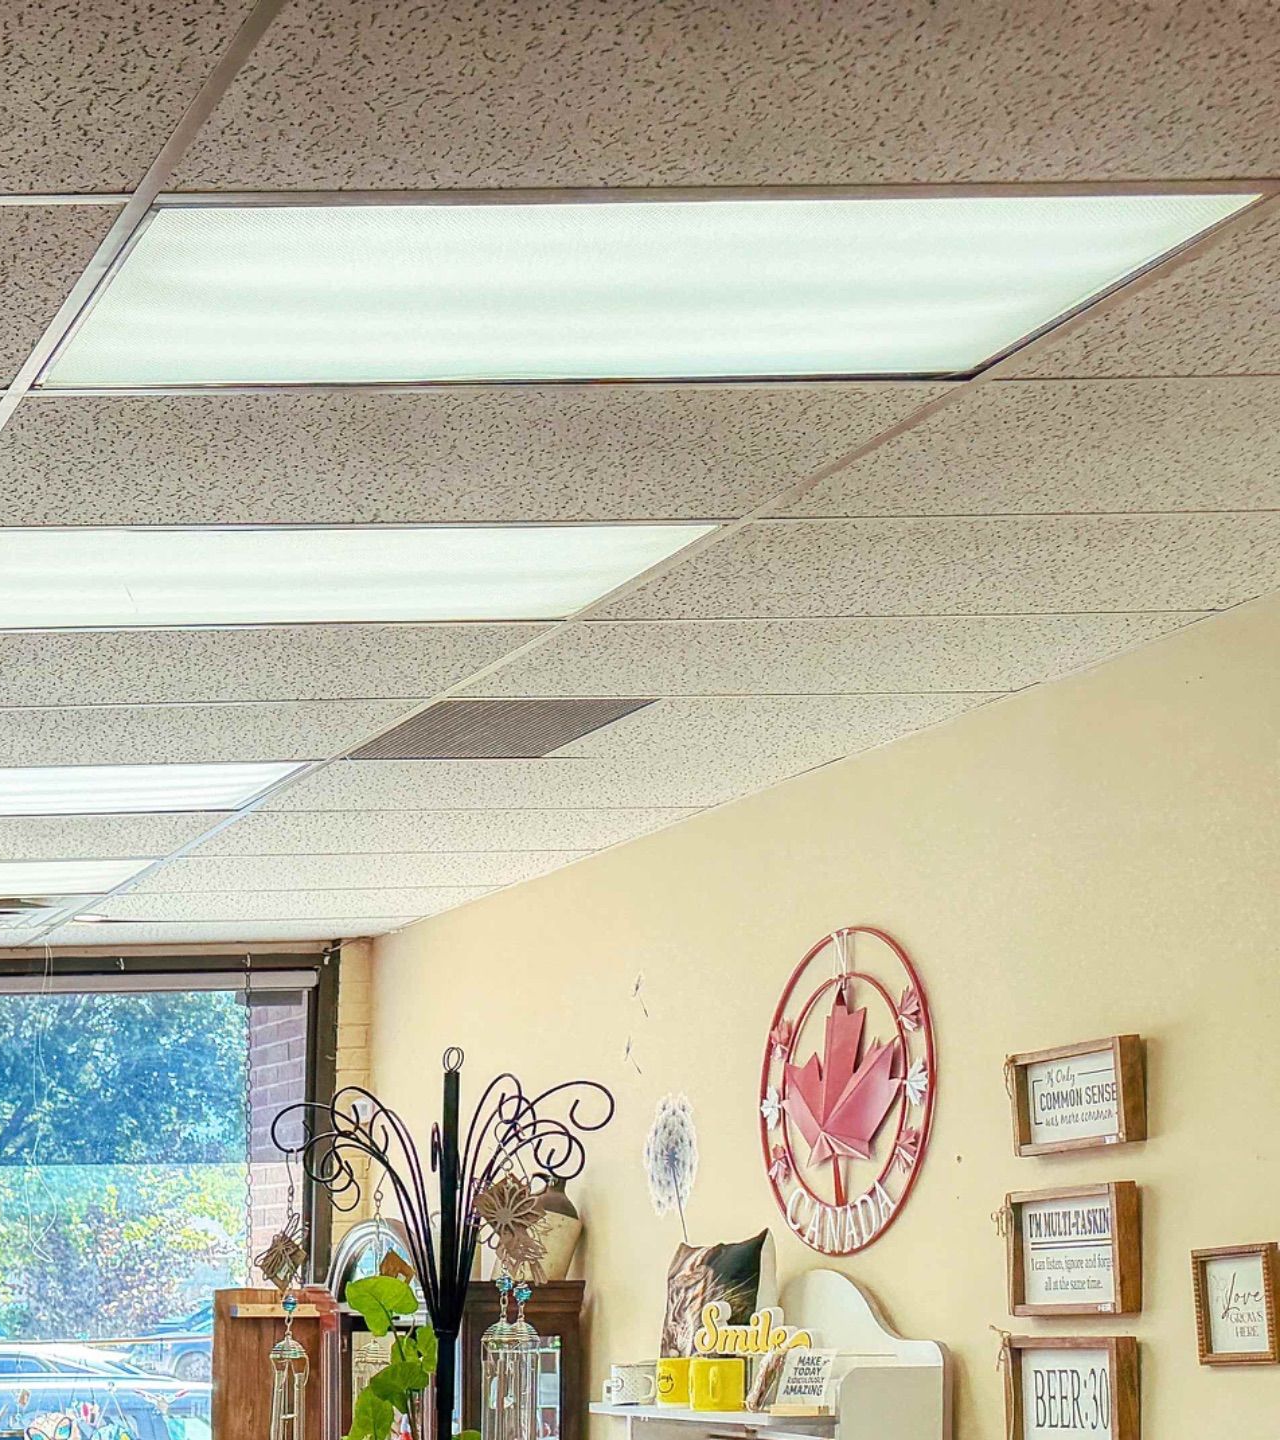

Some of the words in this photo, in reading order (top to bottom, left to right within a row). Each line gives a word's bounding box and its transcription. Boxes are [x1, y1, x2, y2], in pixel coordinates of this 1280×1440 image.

[1056, 1066, 1075, 1086] Only
[1040, 1088, 1082, 1111] COMMON
[1085, 1082, 1117, 1104] SENSE
[1045, 1115, 1058, 1126] was
[1061, 1113, 1079, 1124] more
[1081, 1109, 1113, 1122] common
[787, 1182, 896, 1254] CANADA
[1029, 1213, 1042, 1238] I'M
[1044, 1207, 1110, 1237] MULTI-TASKIN
[1035, 1261, 1045, 1270] can
[1065, 1256, 1084, 1272] ignore
[1085, 1254, 1096, 1268] and
[1097, 1253, 1112, 1271] forg
[1060, 1276, 1069, 1290] the
[1070, 1280, 1086, 1290] same
[1221, 1272, 1265, 1319] Love
[695, 1304, 787, 1353] Smile
[797, 1356, 822, 1366] MAKE
[793, 1367, 822, 1376] TODAY
[783, 1384, 823, 1395] AMAZING
[1033, 1369, 1112, 1433] BEER:30
